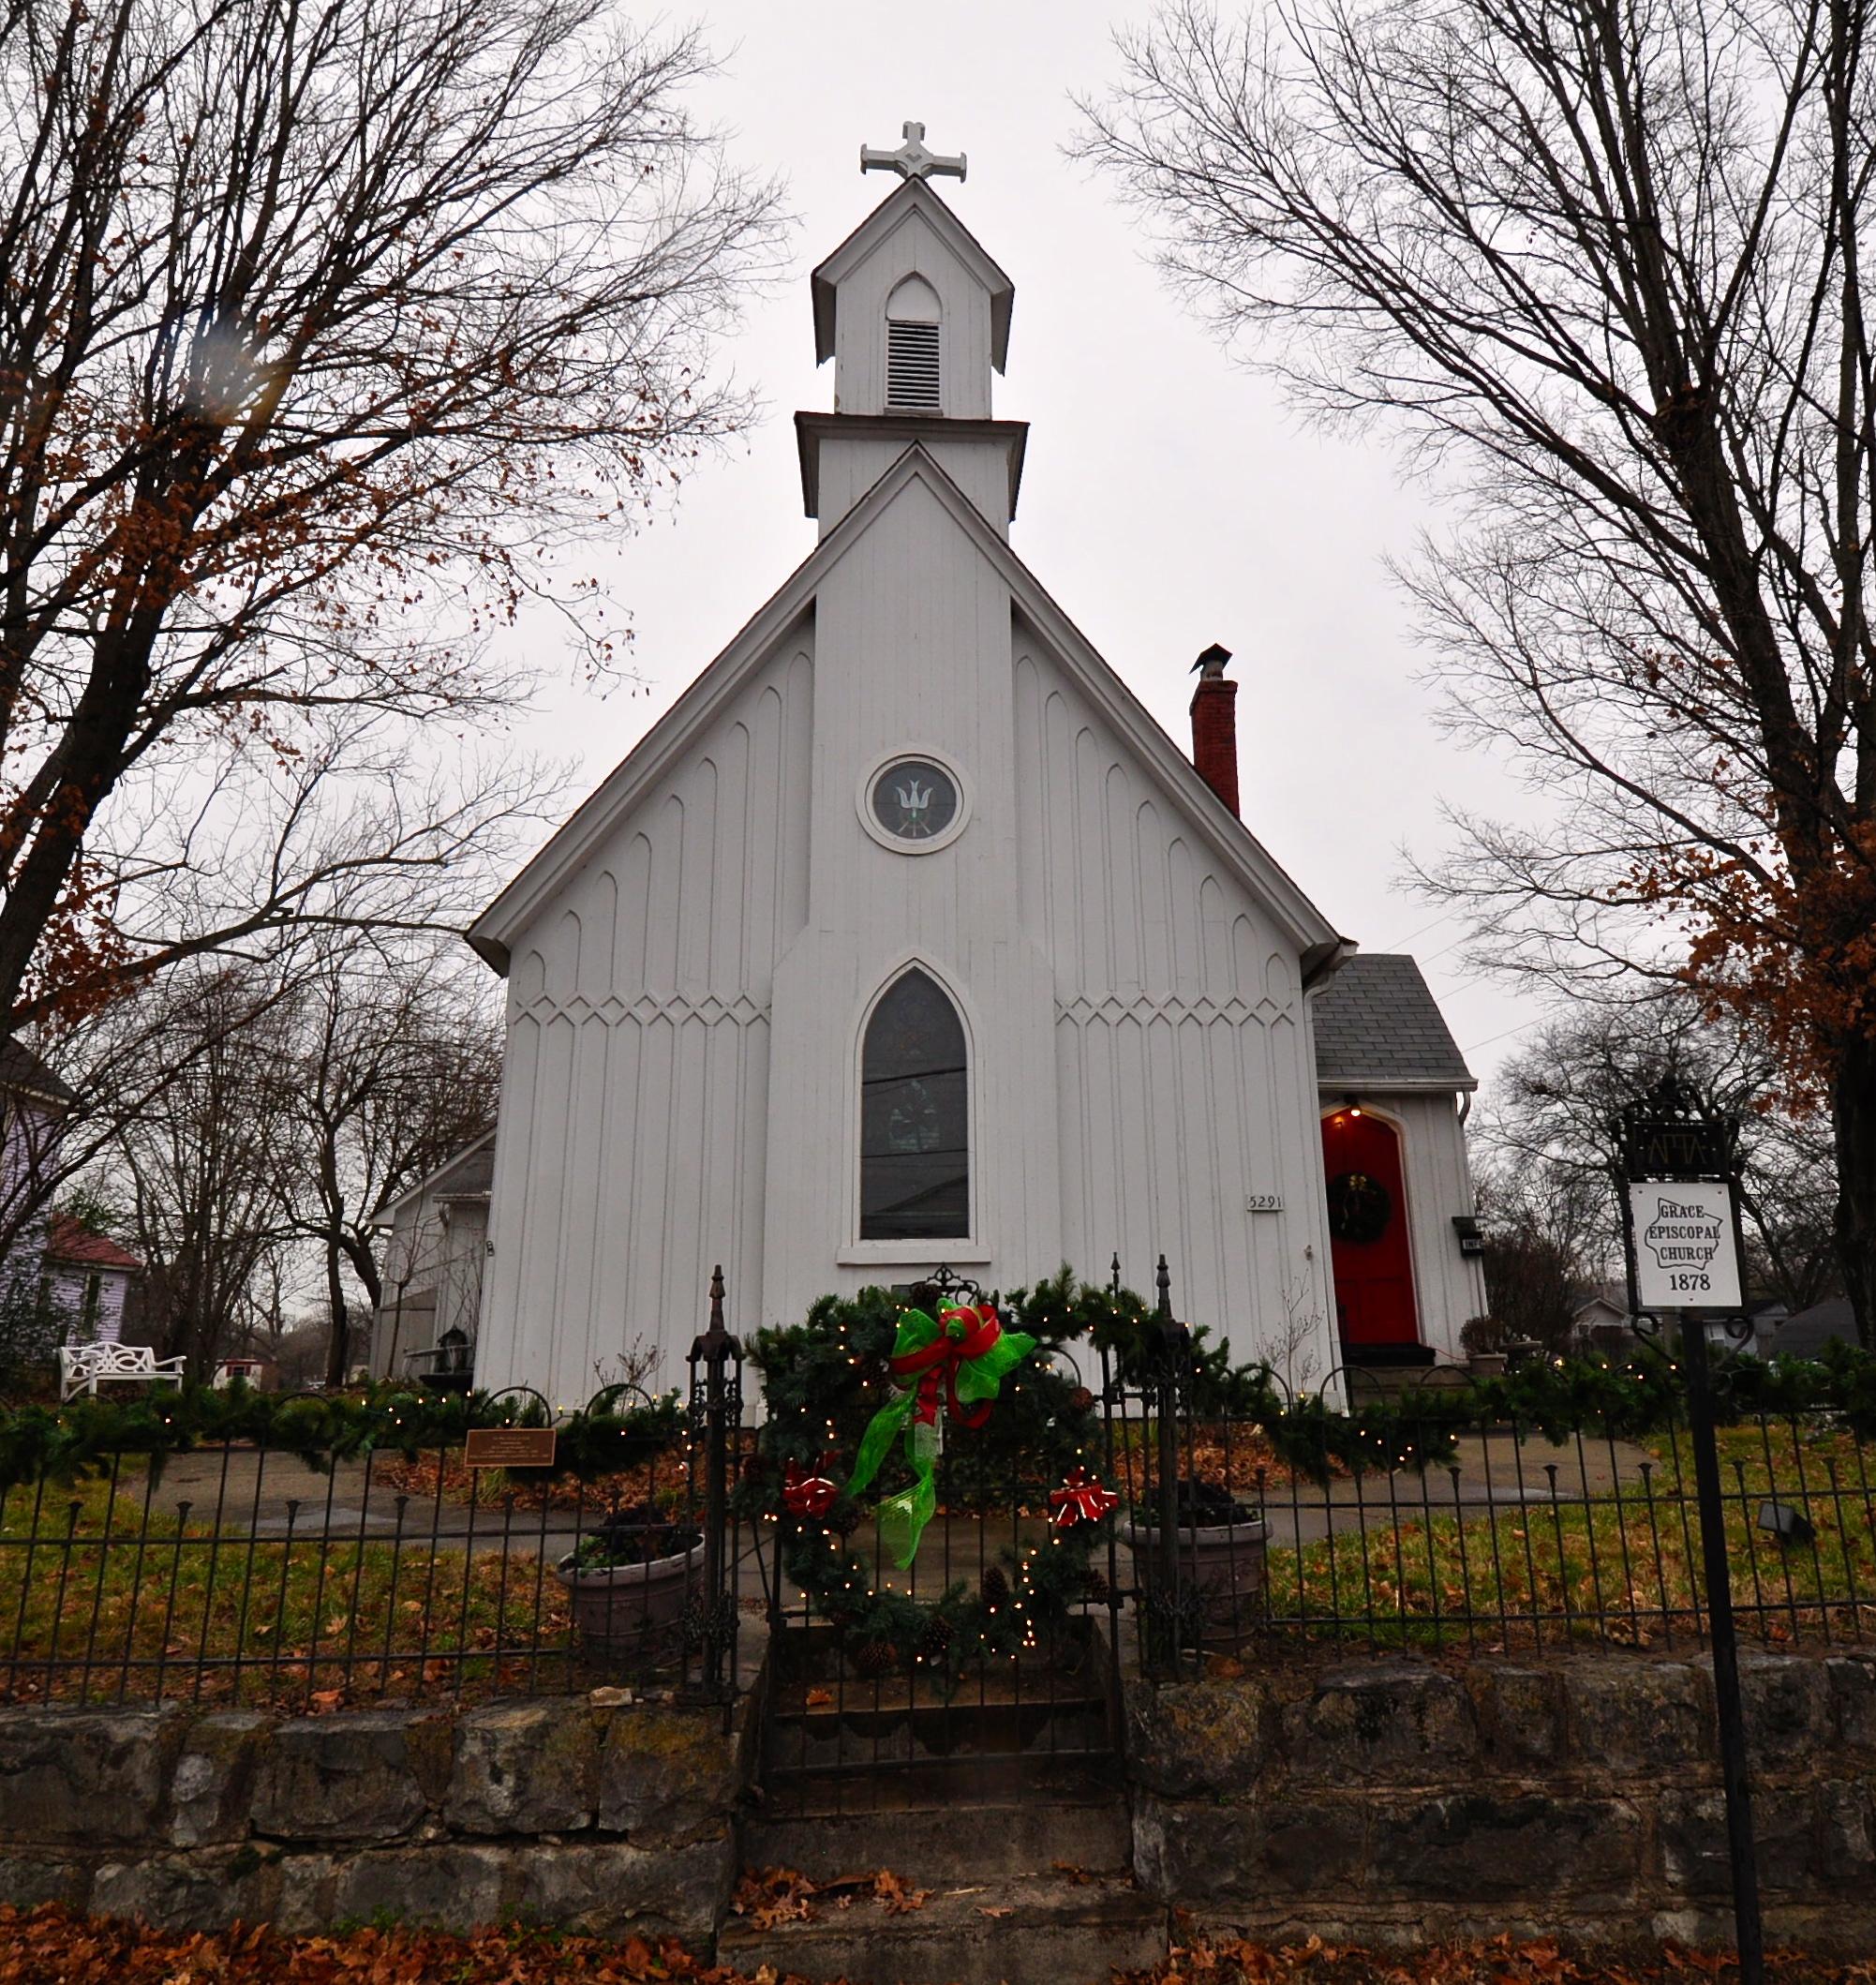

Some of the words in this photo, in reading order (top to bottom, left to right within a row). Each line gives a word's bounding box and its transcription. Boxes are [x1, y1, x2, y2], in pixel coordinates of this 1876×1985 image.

[1249, 1195, 1281, 1208] 5291
[1660, 1205, 1705, 1218] GRACE
[1648, 1226, 1720, 1239] EPISCOPAL
[1660, 1246, 1714, 1260] CHURCH
[1670, 1273, 1711, 1291] 1878
